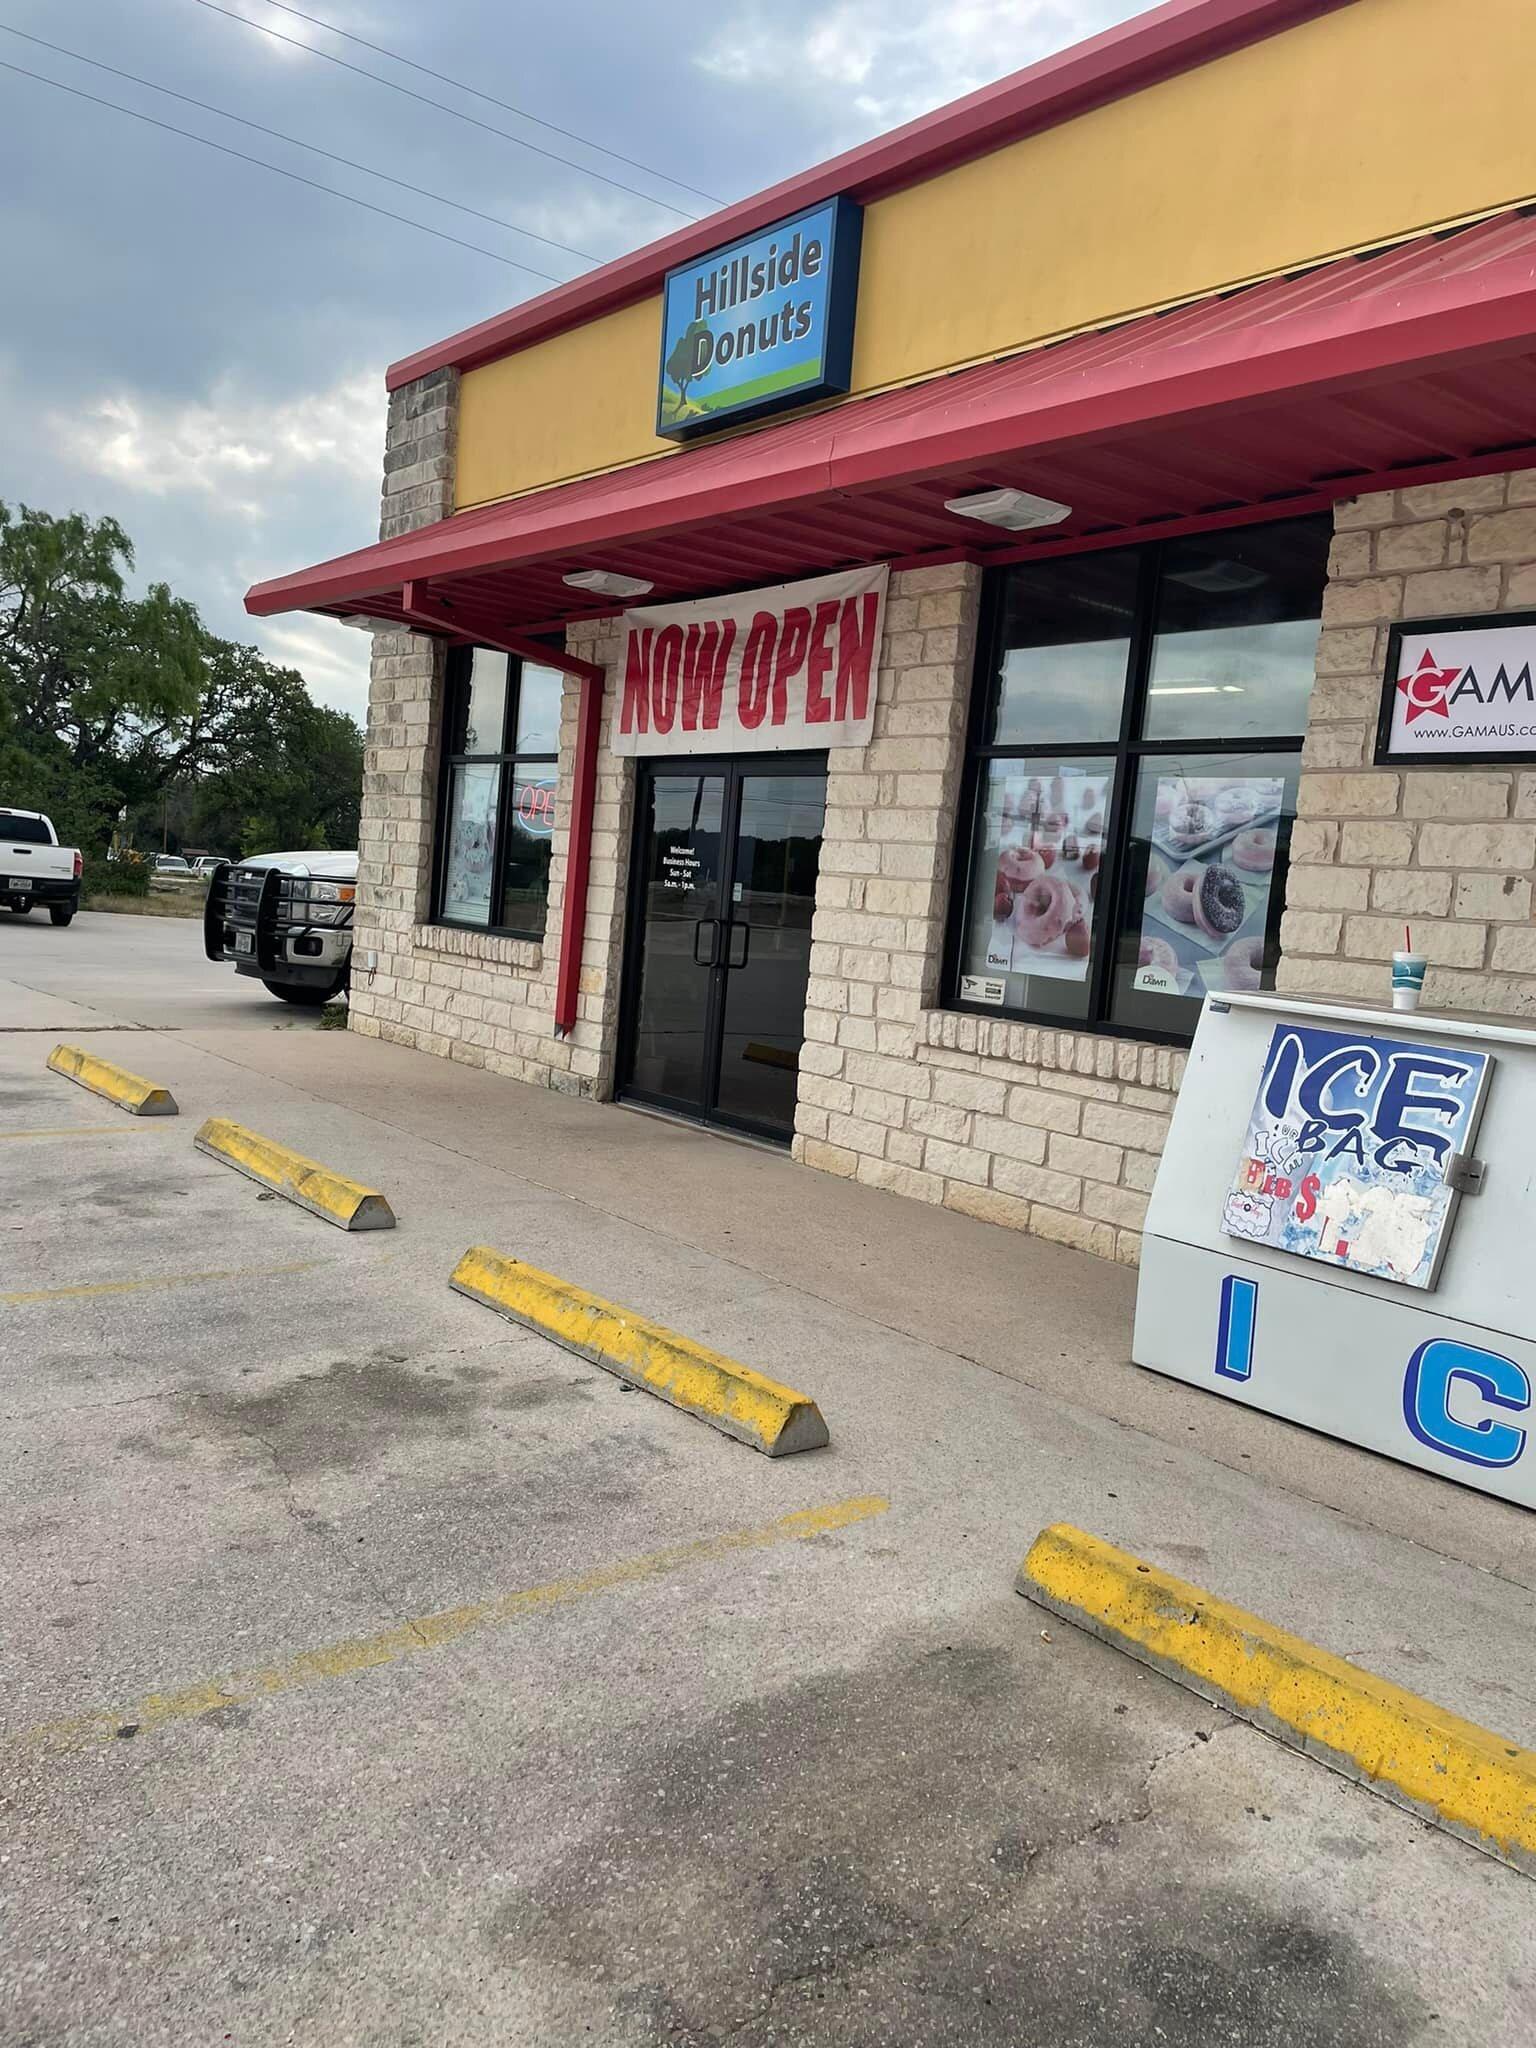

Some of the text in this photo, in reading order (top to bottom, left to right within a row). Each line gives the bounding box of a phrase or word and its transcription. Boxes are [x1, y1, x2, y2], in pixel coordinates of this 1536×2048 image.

[695, 232, 822, 322] Hillside
[691, 300, 813, 377] Donuts
[619, 591, 879, 735] NOW OPEN
[988, 953, 1008, 966] Dawn
[1142, 974, 1167, 987] Dawn
[1264, 1033, 1474, 1168] ICE
[1296, 1119, 1424, 1178] BAG
